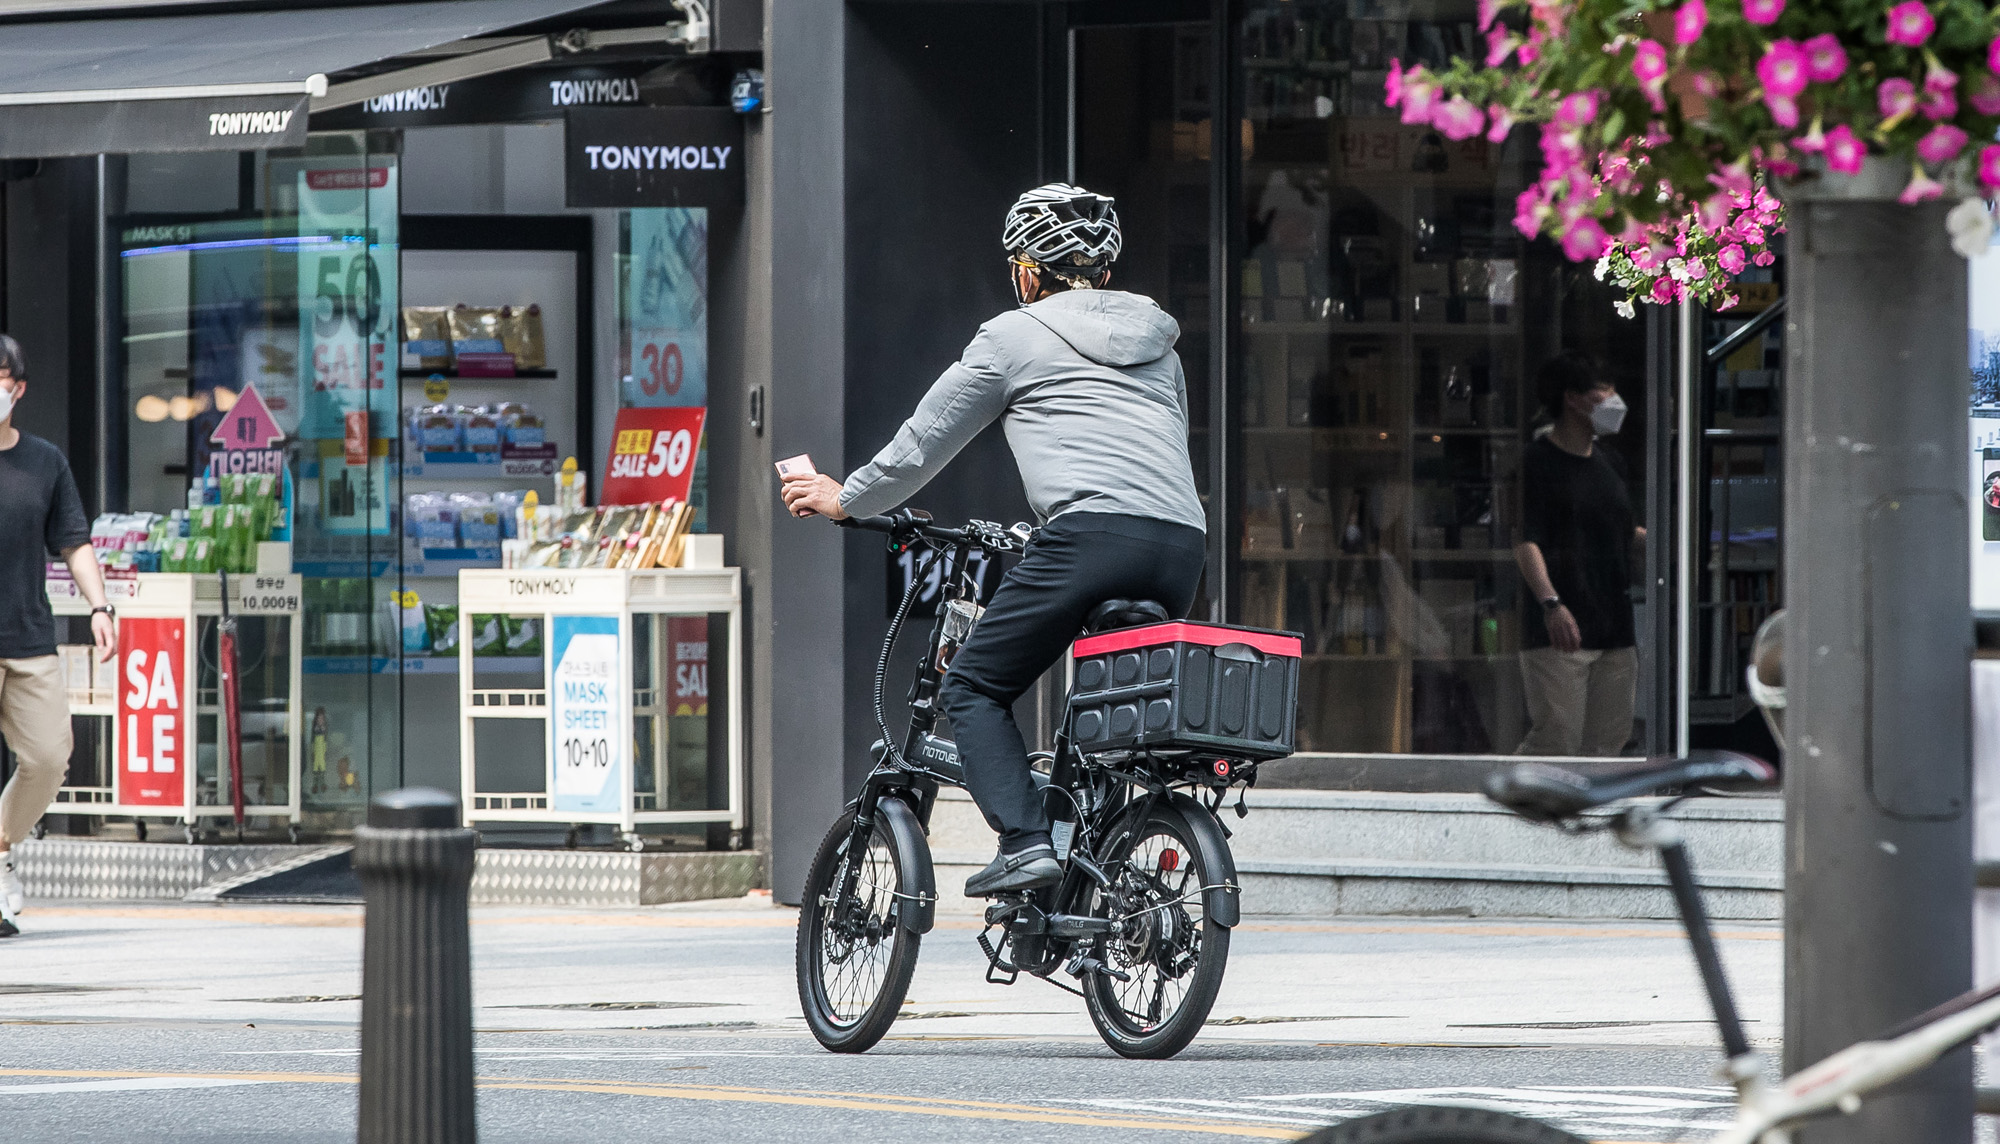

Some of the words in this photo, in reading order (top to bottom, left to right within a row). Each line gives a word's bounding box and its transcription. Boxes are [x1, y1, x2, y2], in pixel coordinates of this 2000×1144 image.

[209, 110, 293, 136] TONYMOLY
[585, 145, 732, 170] TONYMOLY
[315, 255, 382, 338] 50
[312, 343, 385, 391] SALE
[640, 343, 684, 397] 30
[611, 454, 648, 478] SALE
[647, 429, 692, 478] 50
[509, 579, 576, 595] TONYMOLY
[564, 681, 608, 703] MASK
[564, 710, 608, 729] SHEET
[563, 738, 608, 767] 10+10
[922, 745, 961, 767] MOTOVEL
